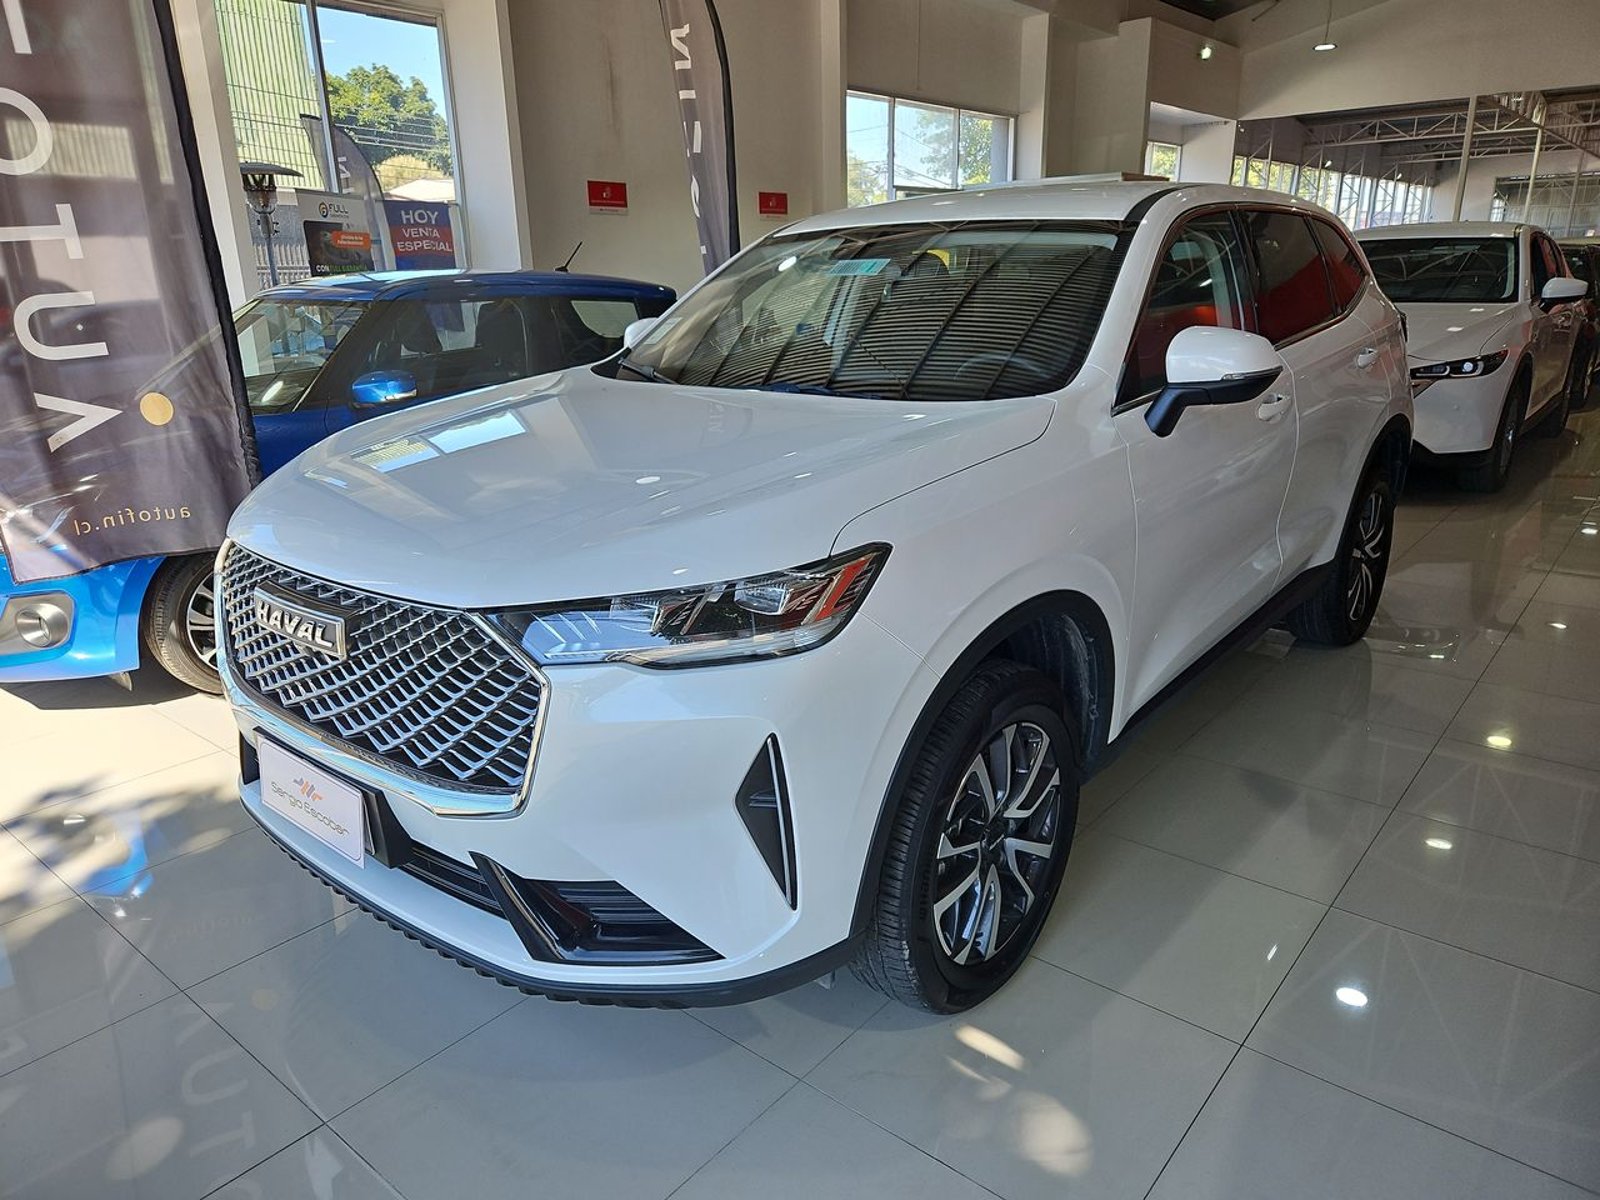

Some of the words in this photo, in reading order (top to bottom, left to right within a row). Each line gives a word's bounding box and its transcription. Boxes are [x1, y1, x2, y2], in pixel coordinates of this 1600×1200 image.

[400, 209, 438, 225] HOY
[402, 227, 441, 239] VENTA
[397, 240, 453, 252] ESPECIAL
[315, 264, 330, 272] CON
[257, 600, 333, 648] HAVAL
